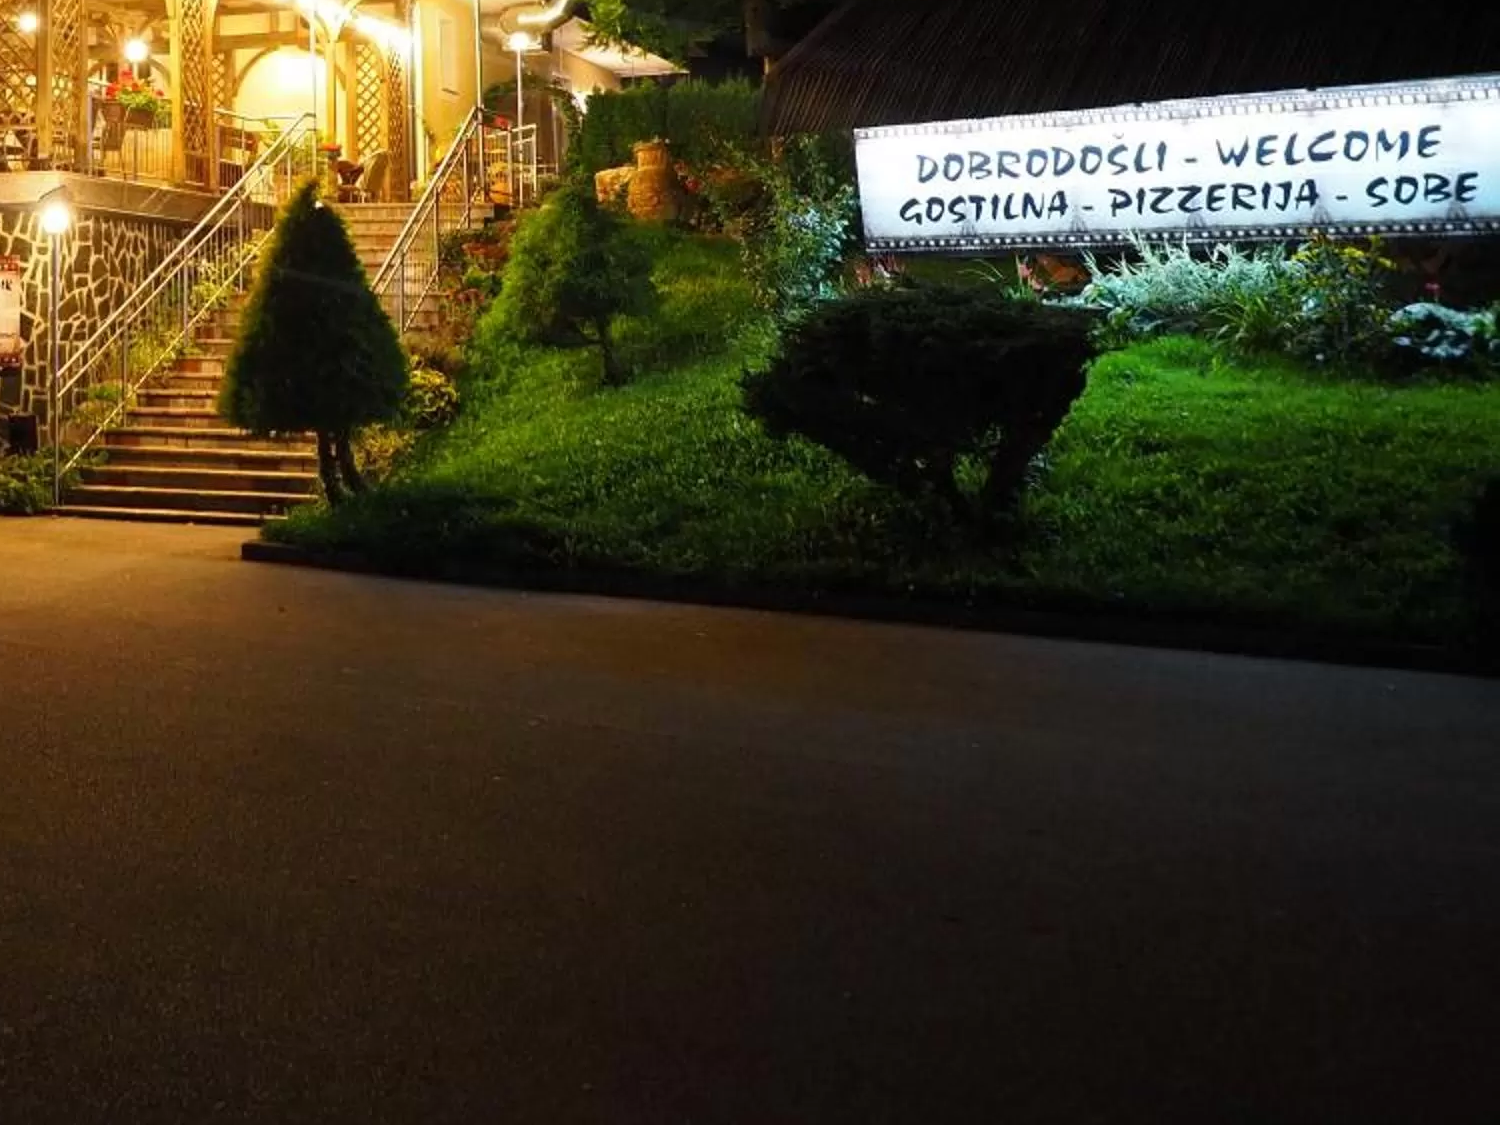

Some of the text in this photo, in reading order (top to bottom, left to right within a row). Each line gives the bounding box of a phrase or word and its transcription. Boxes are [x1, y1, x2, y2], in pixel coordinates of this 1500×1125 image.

[916, 132, 1167, 183] DOBRODOŠLI
[1215, 125, 1442, 168] WELCOME
[899, 190, 1069, 226] GOSTILNA
[1107, 178, 1321, 218] PIZZERIJA
[1366, 172, 1480, 208] SOBE
